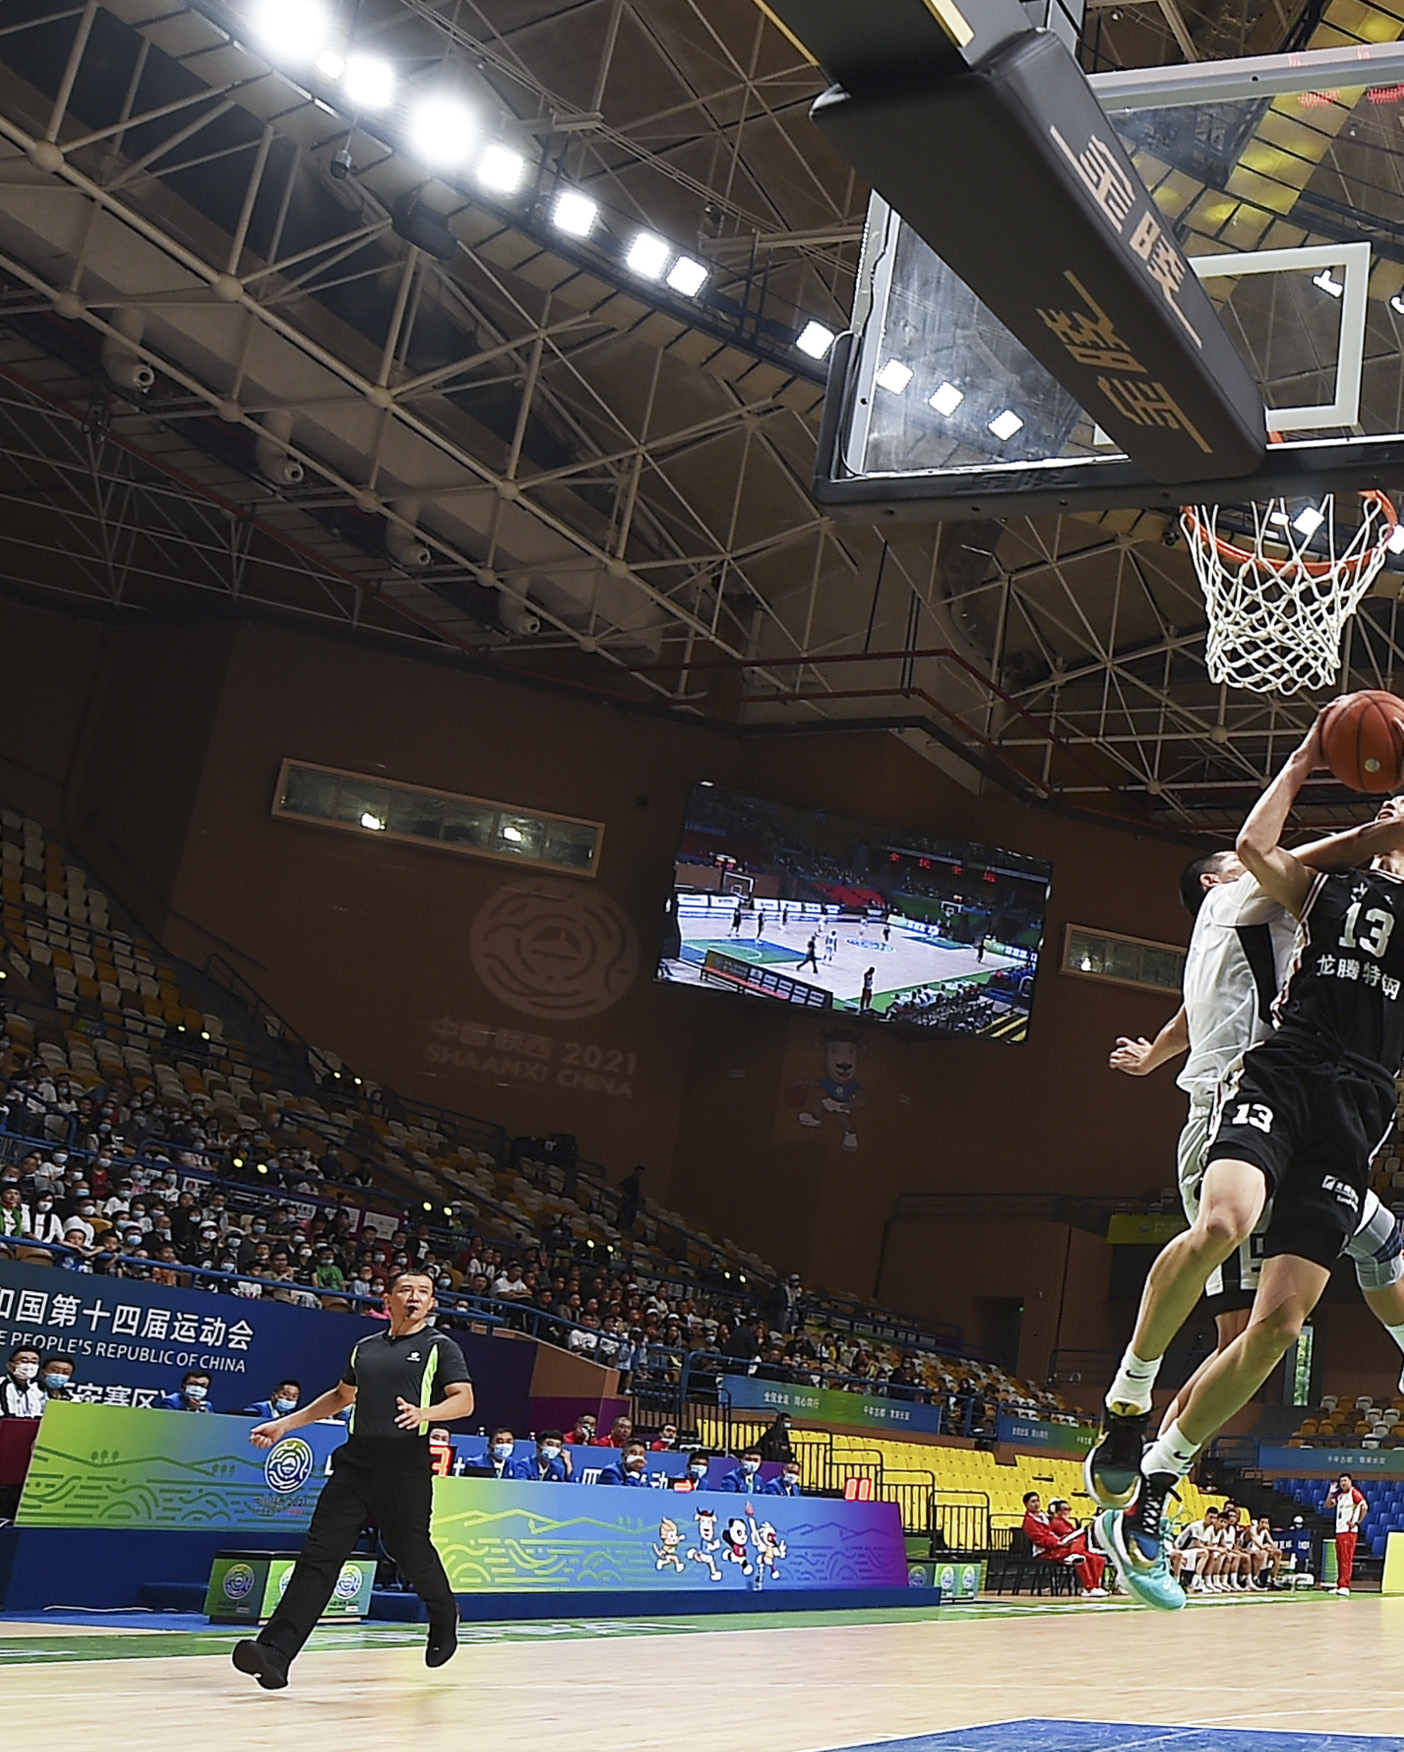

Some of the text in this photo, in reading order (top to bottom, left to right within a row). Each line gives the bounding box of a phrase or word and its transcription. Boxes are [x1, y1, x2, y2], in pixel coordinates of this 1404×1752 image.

[1338, 902, 1395, 958] 13
[1316, 953, 1401, 1000] 龙腾特钢
[424, 1043, 633, 1098] SHAANXI CHINA
[561, 1041, 637, 1075] 2021
[1231, 1103, 1274, 1133] 13
[10, 1332, 92, 1356] PEOPLE'S
[96, 1341, 173, 1367] REPUBLIC
[176, 1352, 197, 1367] OF
[199, 1355, 246, 1373] CHINA
